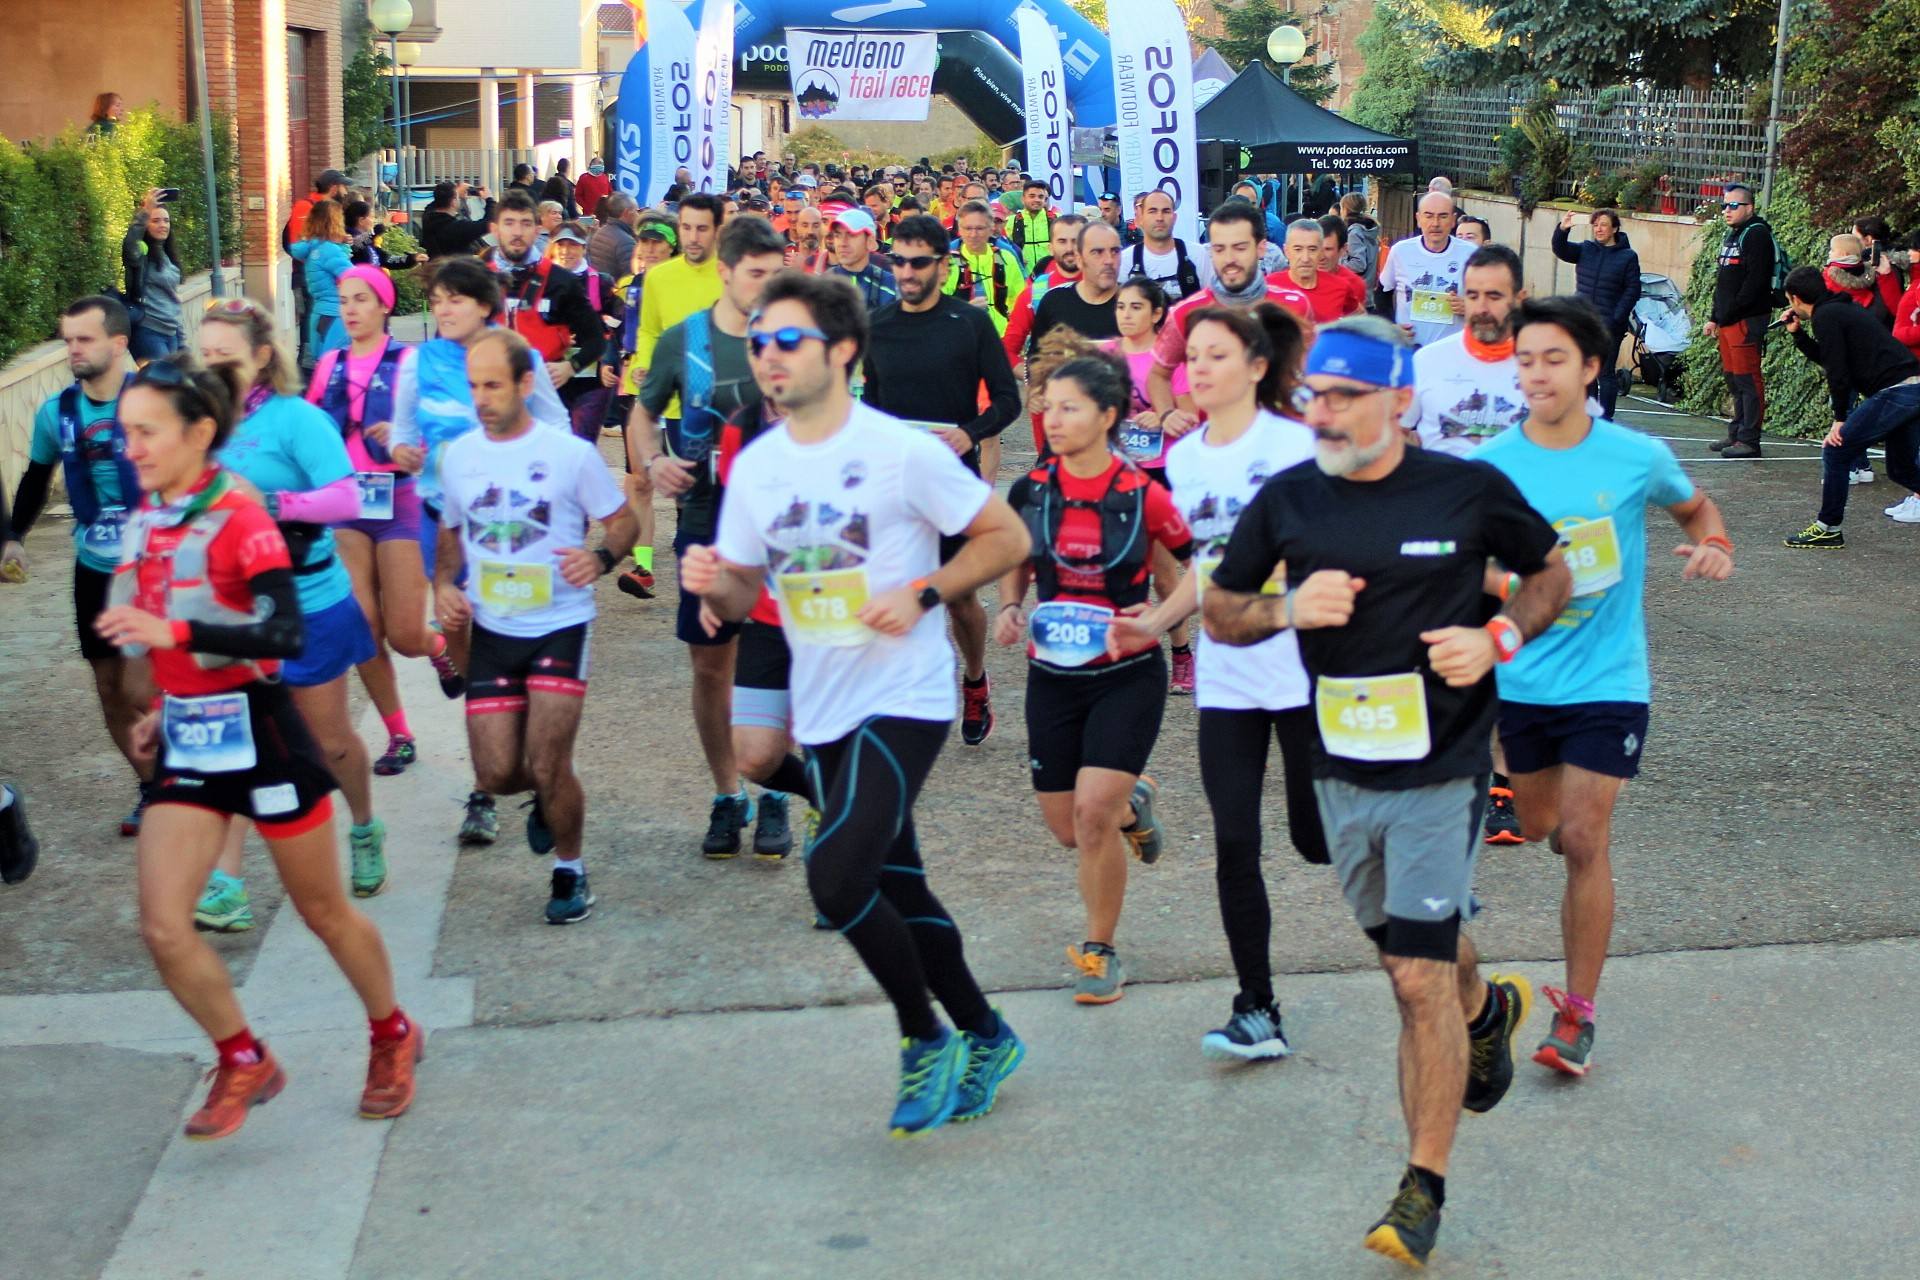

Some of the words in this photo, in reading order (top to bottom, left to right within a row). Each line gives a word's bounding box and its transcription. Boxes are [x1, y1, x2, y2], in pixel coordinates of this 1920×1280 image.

[806, 34, 906, 70] medrano
[849, 70, 888, 99] trail
[889, 75, 931, 98] race
[973, 66, 987, 81] Pisa
[1010, 102, 1026, 118] mejo
[618, 119, 641, 198] OKS
[1297, 144, 1408, 156] www.podoactiva.com
[1310, 158, 1330, 169] Tel.
[1333, 159, 1352, 169] 902
[1354, 159, 1373, 169] 365
[1375, 159, 1395, 169] 099
[1421, 301, 1444, 313] 481
[94, 523, 126, 541] 21
[492, 581, 534, 599] 498
[801, 596, 848, 620] 478
[1045, 622, 1090, 645] 208
[1338, 704, 1398, 730] 495
[176, 722, 226, 745] 207
